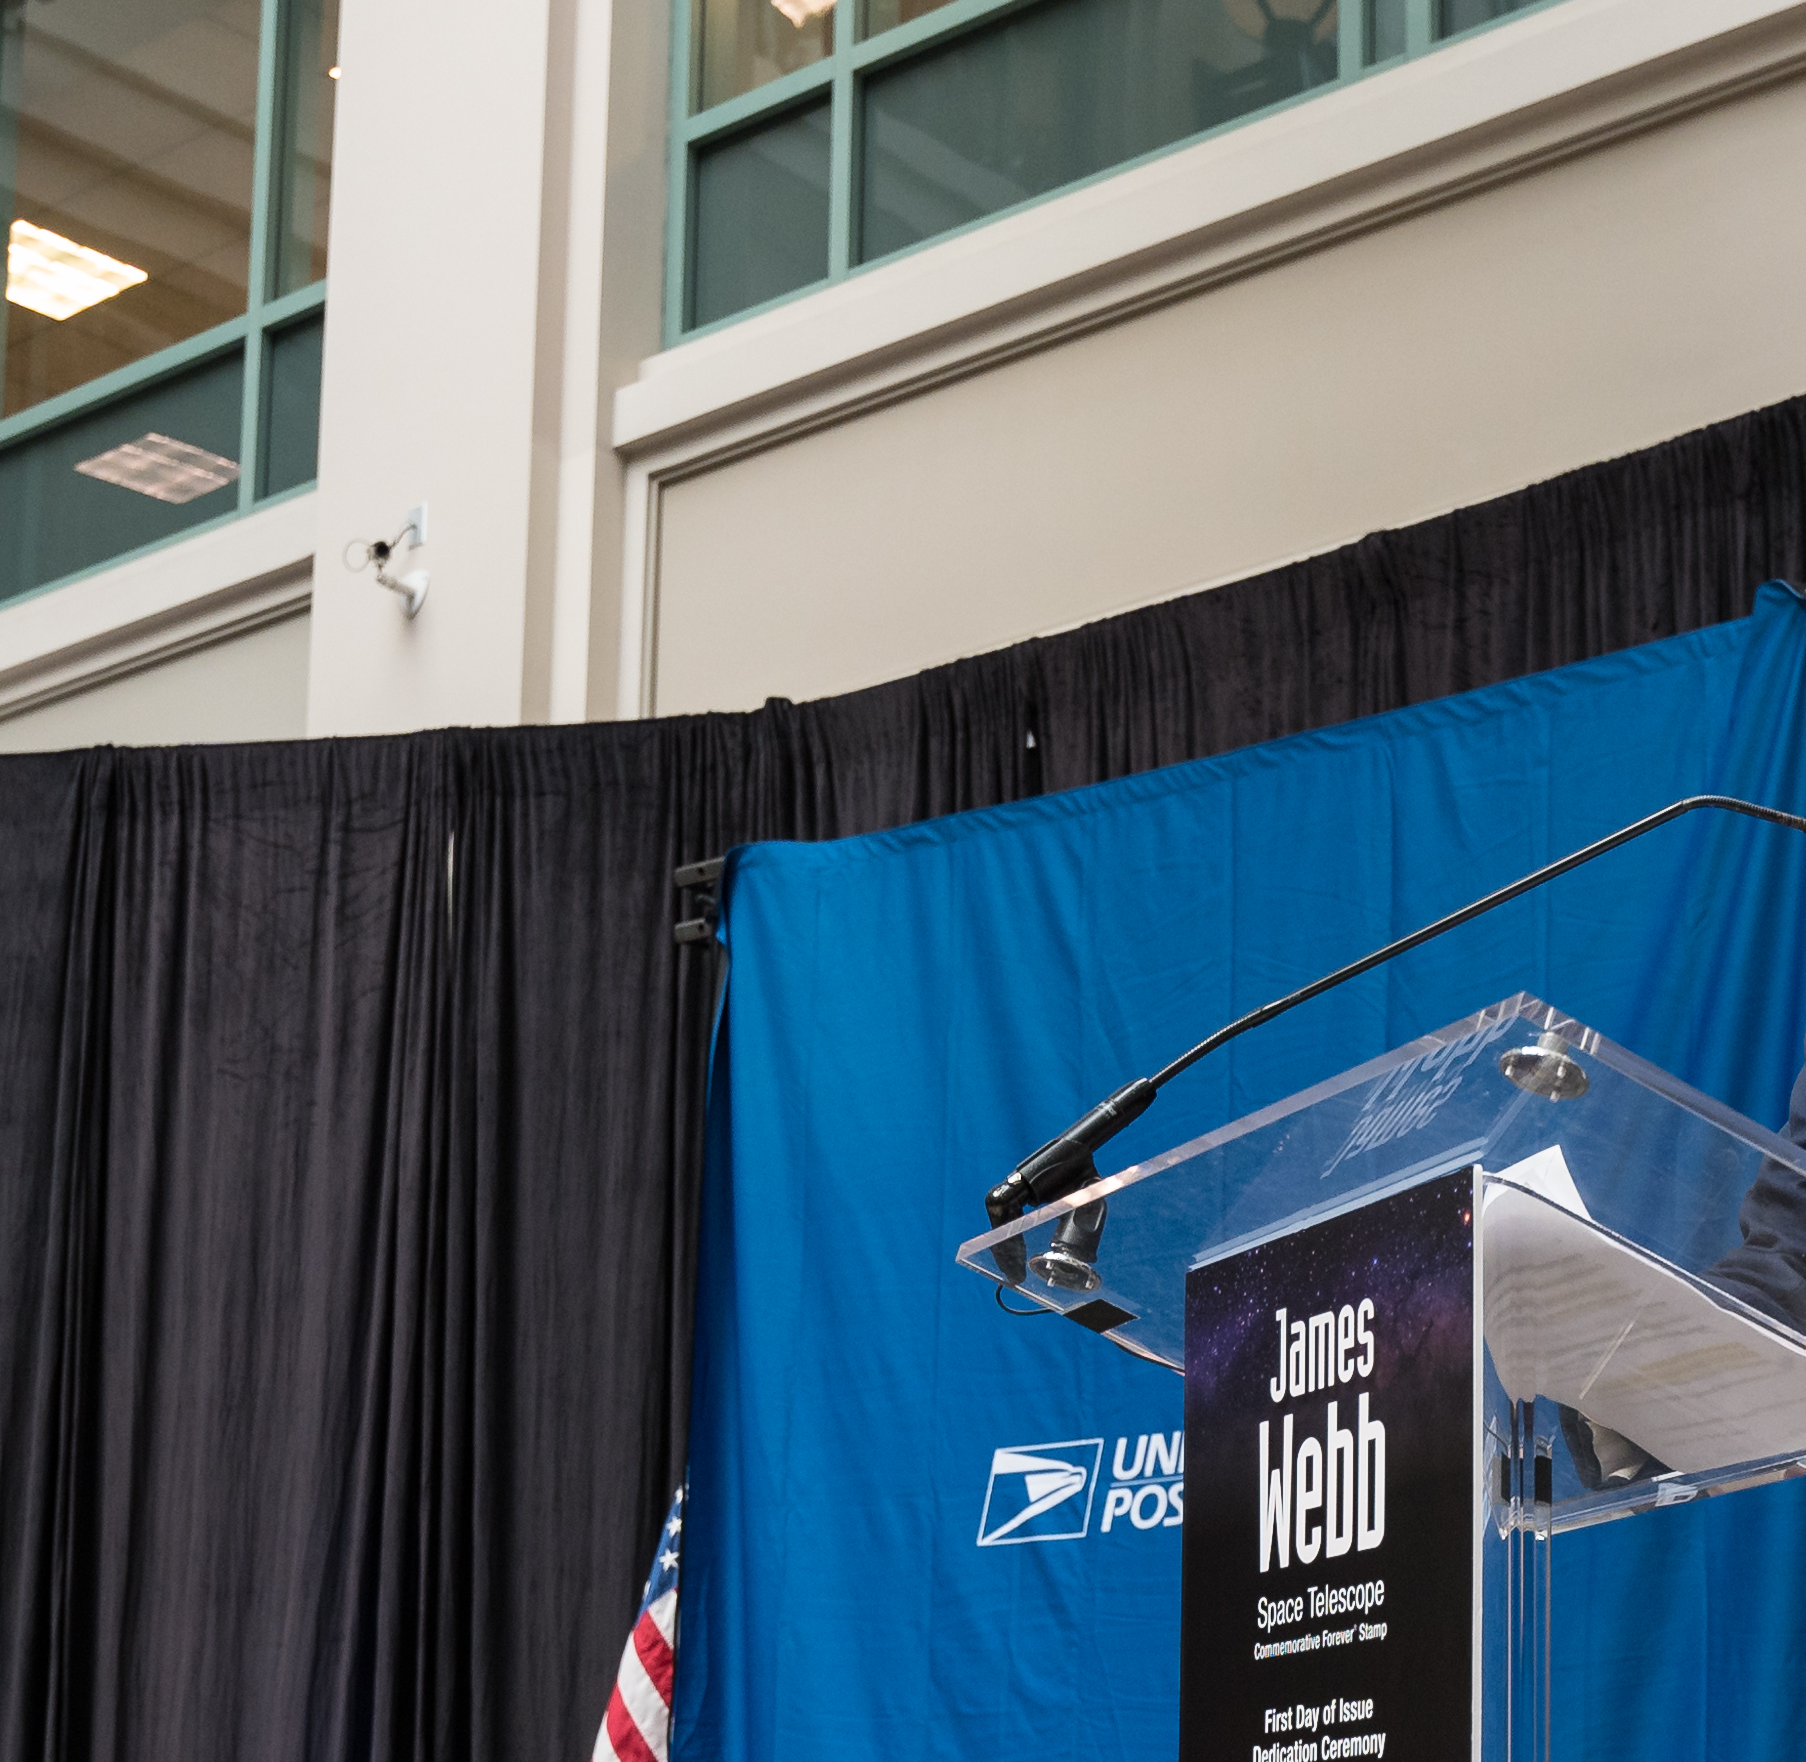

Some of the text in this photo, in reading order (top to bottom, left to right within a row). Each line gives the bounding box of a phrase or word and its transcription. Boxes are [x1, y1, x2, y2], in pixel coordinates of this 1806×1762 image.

[1270, 1298, 1375, 1403] James
[1259, 1392, 1386, 1574] Webb
[1257, 1579, 1385, 1634] Space Telescope
[1254, 1633, 1320, 1661] Commemorative
[1359, 1622, 1388, 1641] Stamp
[1264, 1697, 1374, 1734] First Day of Issue
[1321, 1732, 1386, 1759] Ceremony
